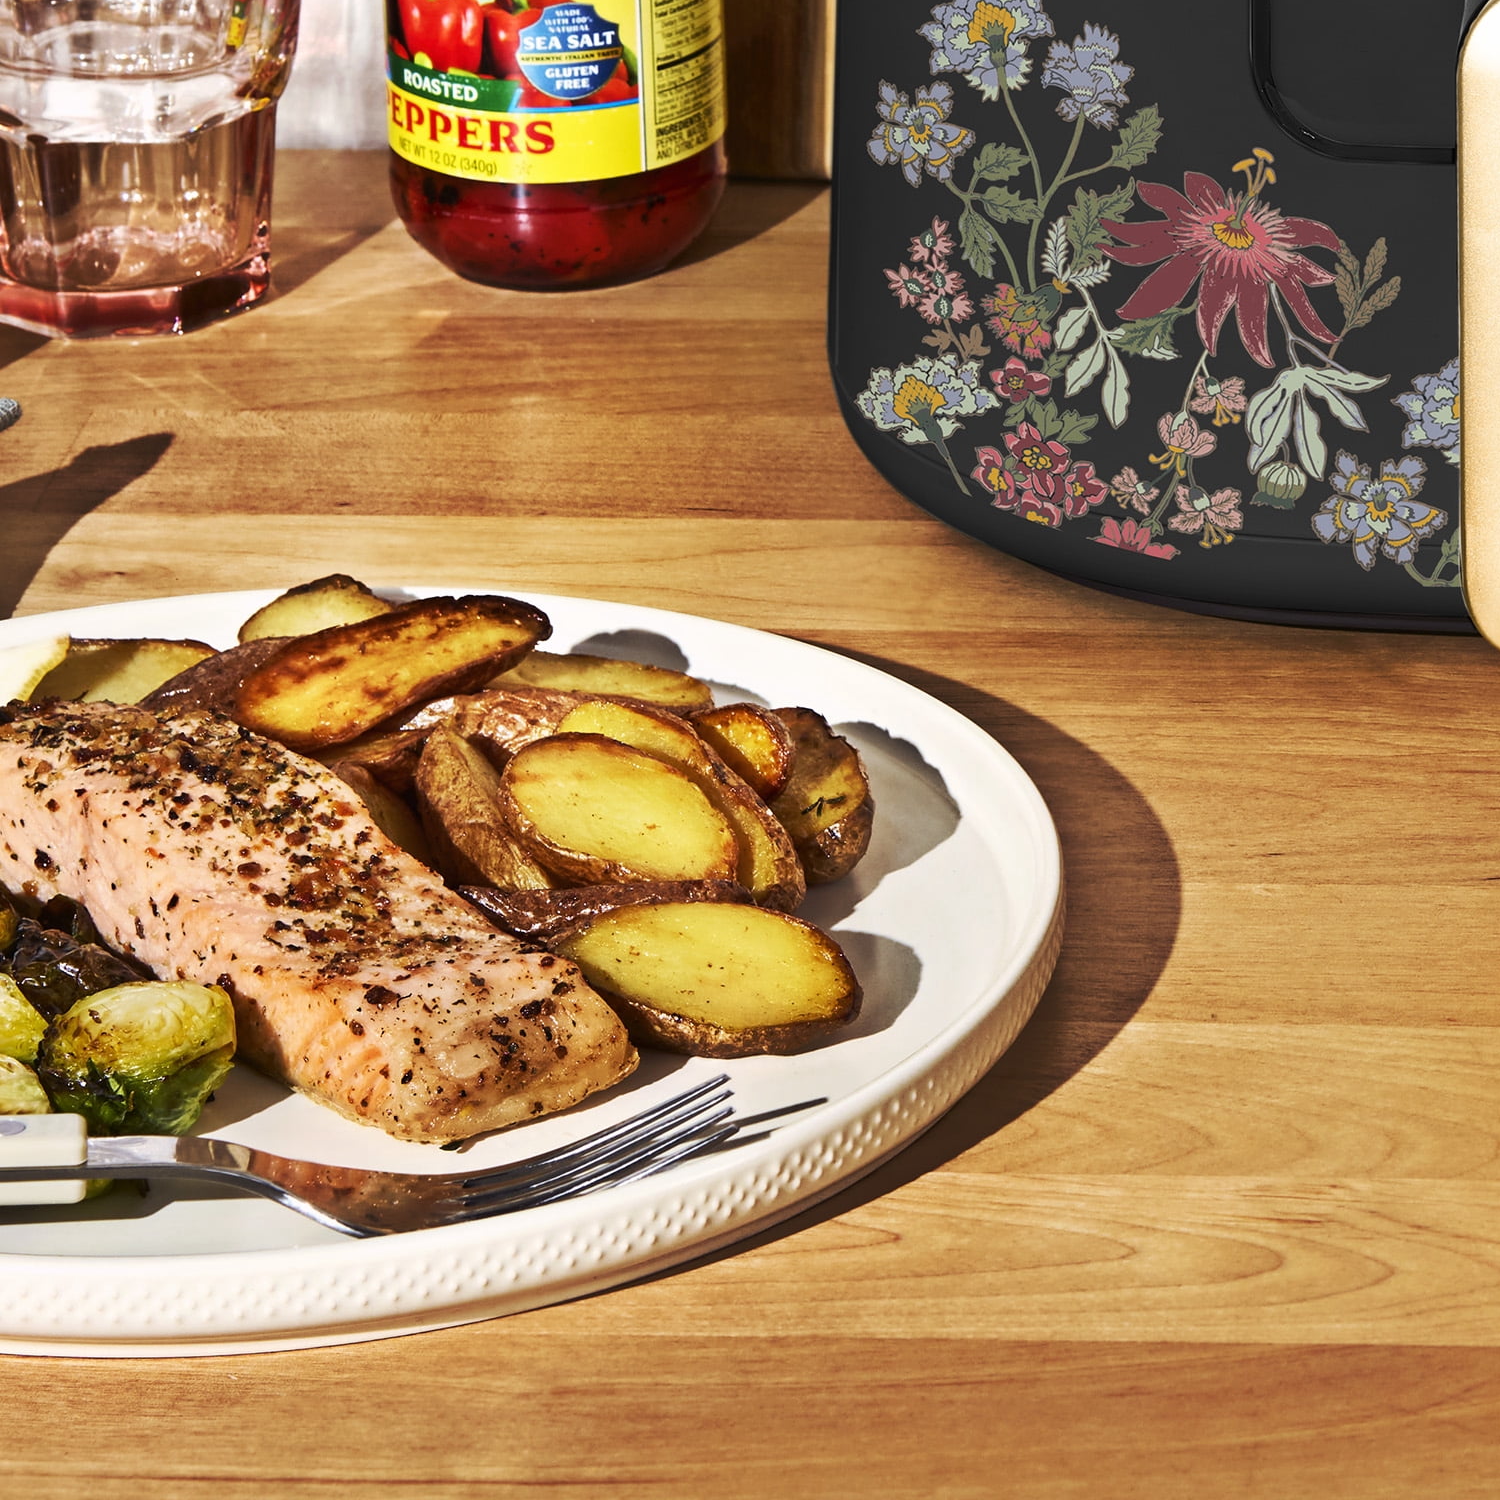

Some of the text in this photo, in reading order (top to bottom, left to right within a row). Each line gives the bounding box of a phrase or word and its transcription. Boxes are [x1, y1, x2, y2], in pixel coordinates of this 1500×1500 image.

[555, 9, 581, 17] MADE
[548, 24, 590, 33] NATURAL
[523, 30, 615, 51] SEA SALT
[545, 64, 599, 79] GLUTEN
[403, 68, 479, 102] ROASTED
[555, 77, 591, 91] FREE
[399, 136, 498, 177] NET WT 12 OZ (340g)
